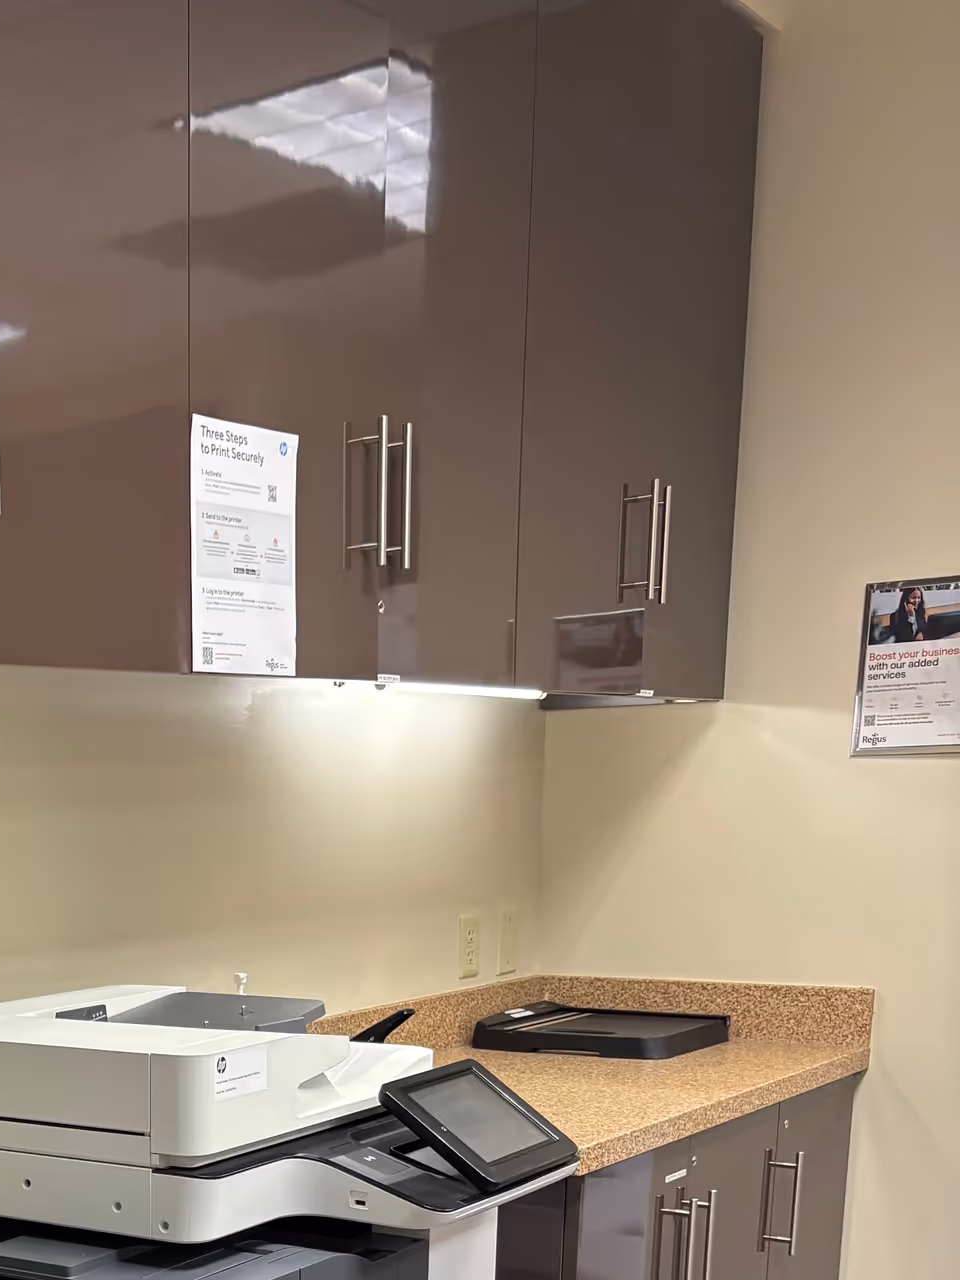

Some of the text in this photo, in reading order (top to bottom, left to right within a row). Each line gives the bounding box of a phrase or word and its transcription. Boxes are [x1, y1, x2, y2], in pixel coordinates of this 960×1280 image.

[200, 424, 248, 447] Three Steps
[201, 442, 265, 467] to Print Securely
[205, 469, 222, 478] Activate
[869, 647, 960, 662] Boost your busines
[868, 658, 940, 671] with our added
[867, 670, 907, 681] services
[862, 733, 887, 746] Regus
